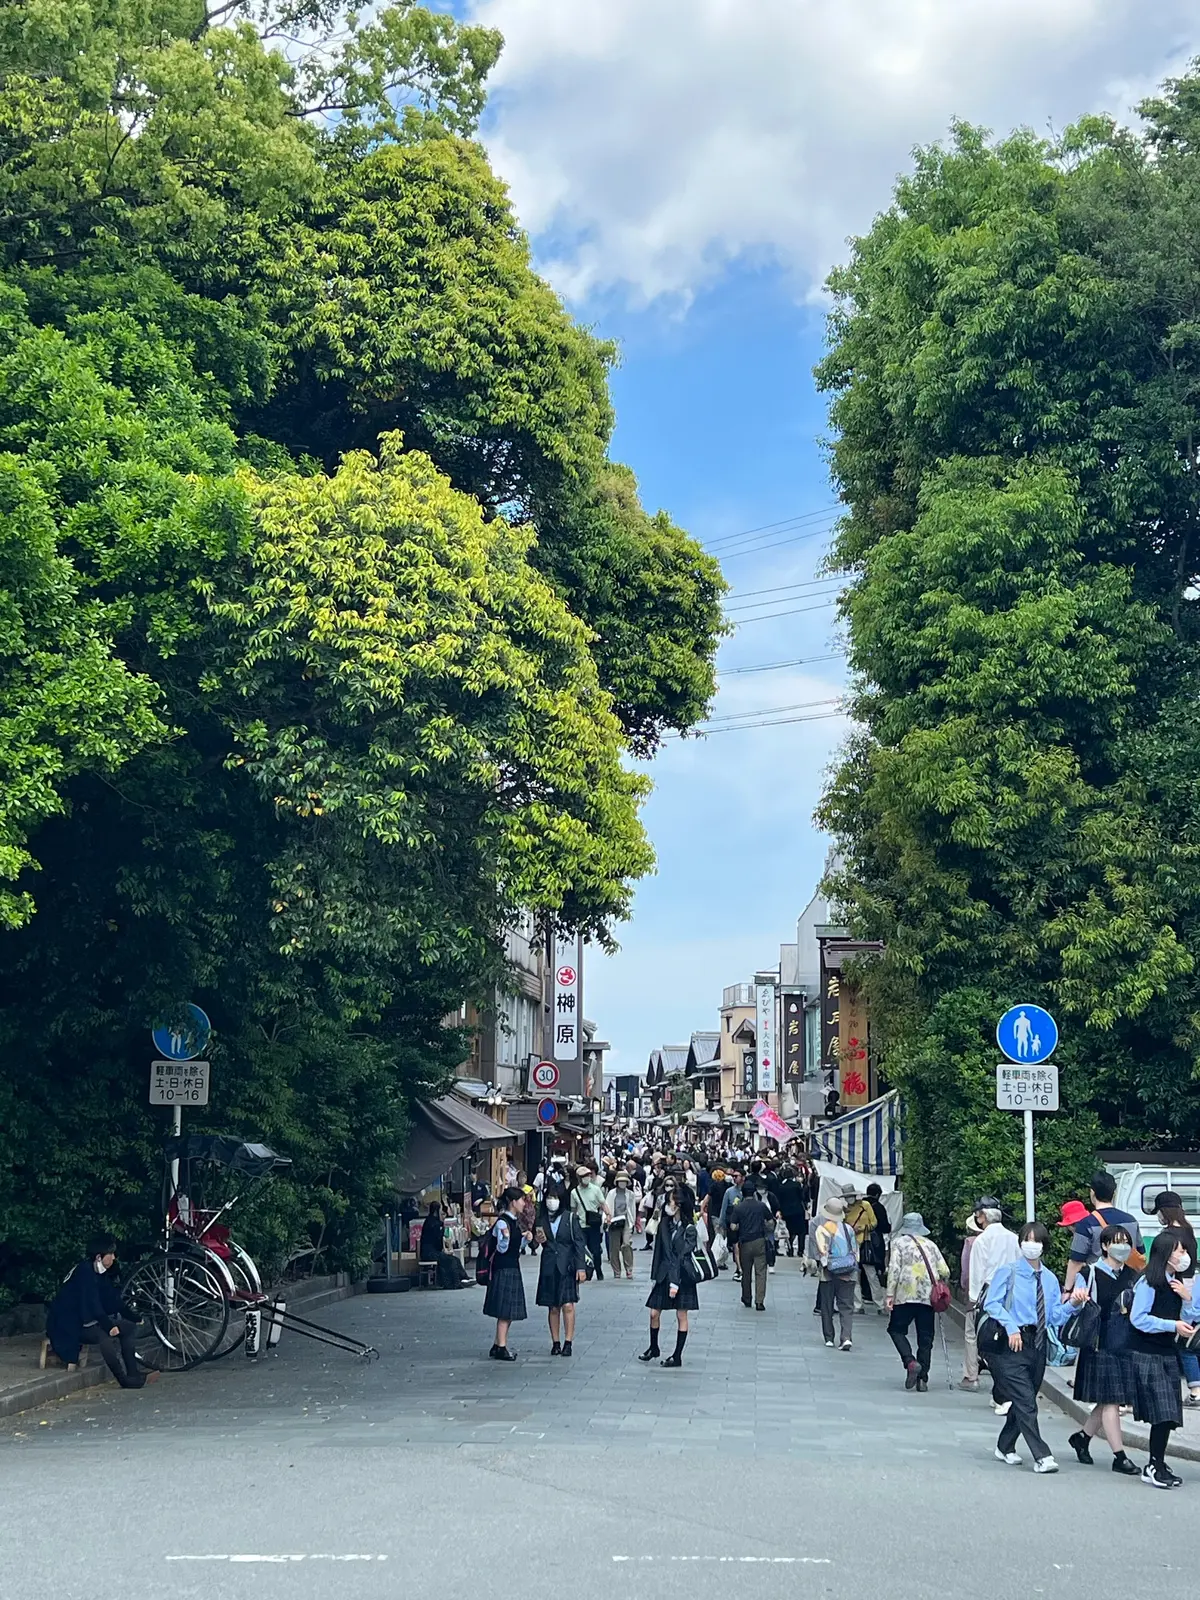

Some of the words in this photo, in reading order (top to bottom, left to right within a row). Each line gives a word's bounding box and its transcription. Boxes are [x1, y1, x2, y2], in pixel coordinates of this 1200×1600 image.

[556, 993, 575, 1043] 榊原
[762, 1031, 771, 1057] 大食堂
[788, 1019, 800, 1075] 岩戸屋
[156, 1065, 204, 1076] 軽車両を除く
[538, 1069, 554, 1082] 30
[1002, 1069, 1052, 1081] 軽車両を除く
[155, 1078, 203, 1088] 土・日・休日
[1002, 1082, 1052, 1093] 土・日・休日
